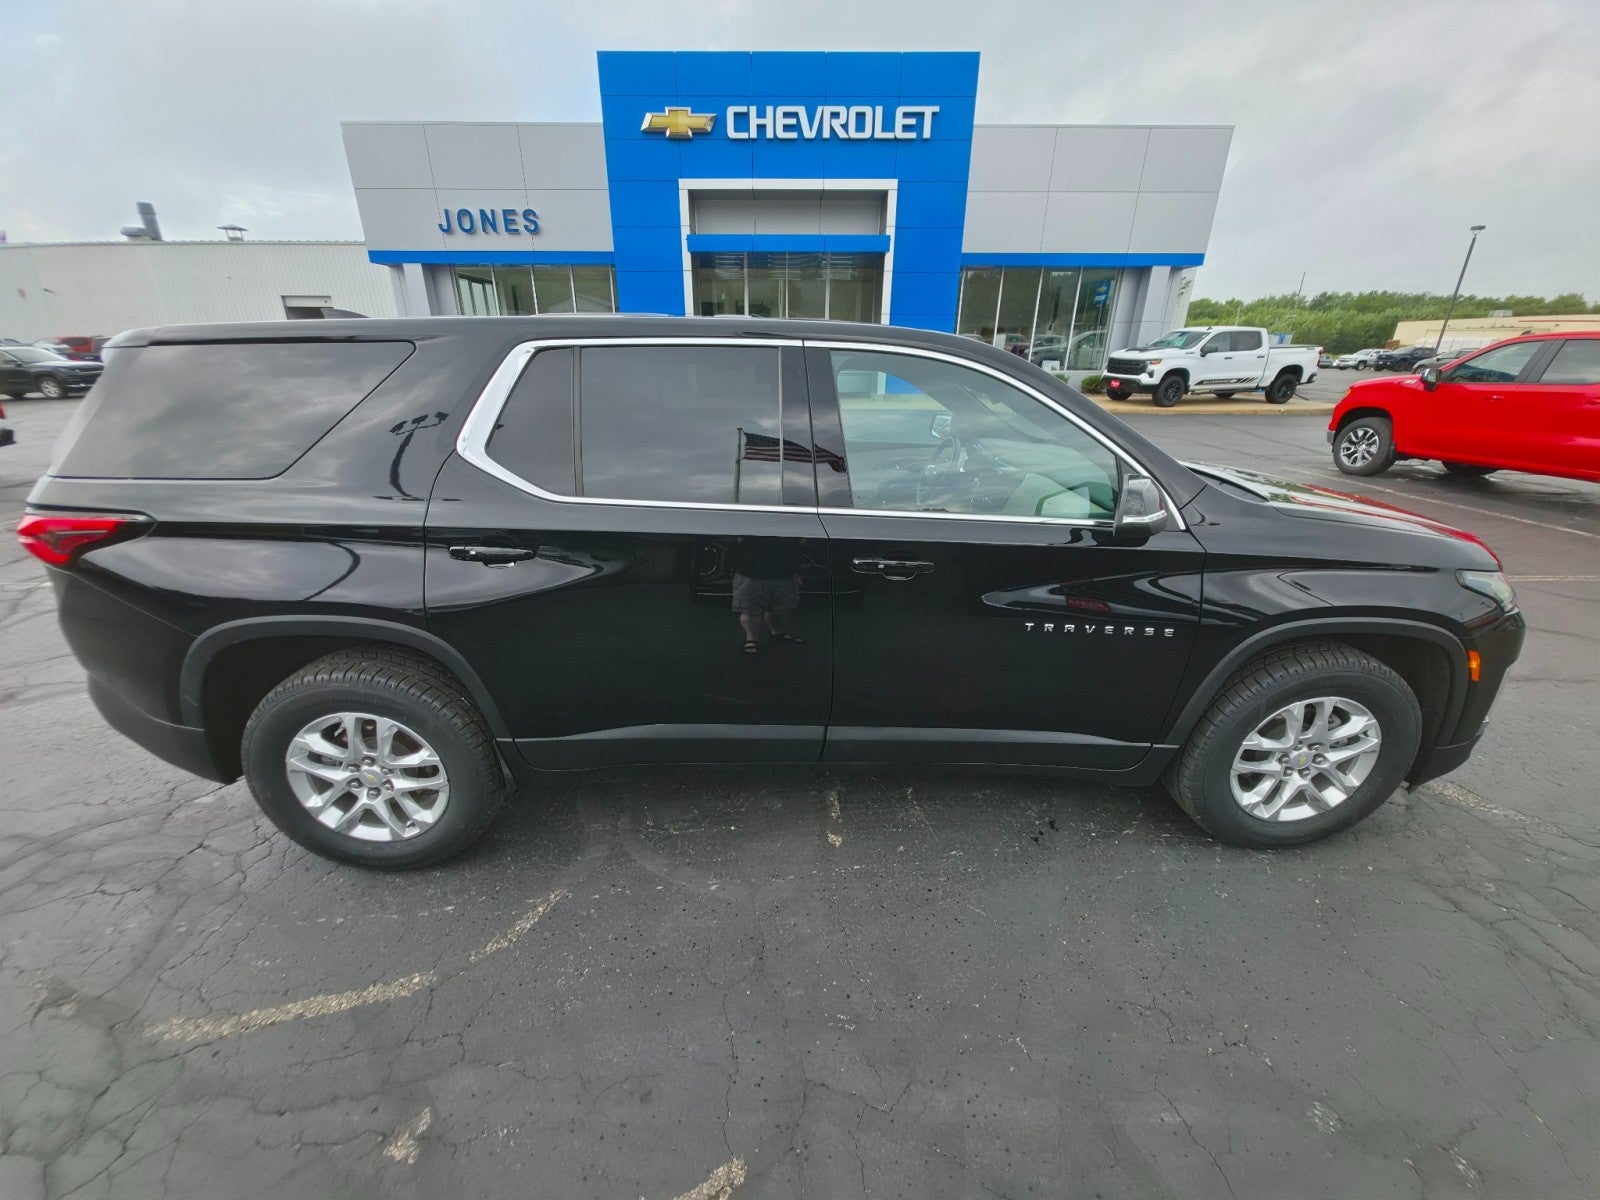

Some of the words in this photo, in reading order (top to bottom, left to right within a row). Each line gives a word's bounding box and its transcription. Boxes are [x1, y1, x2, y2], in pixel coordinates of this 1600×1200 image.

[726, 105, 940, 140] CHEVROLET
[438, 208, 540, 235] JONES
[1024, 622, 1175, 637] TRAVERSE
